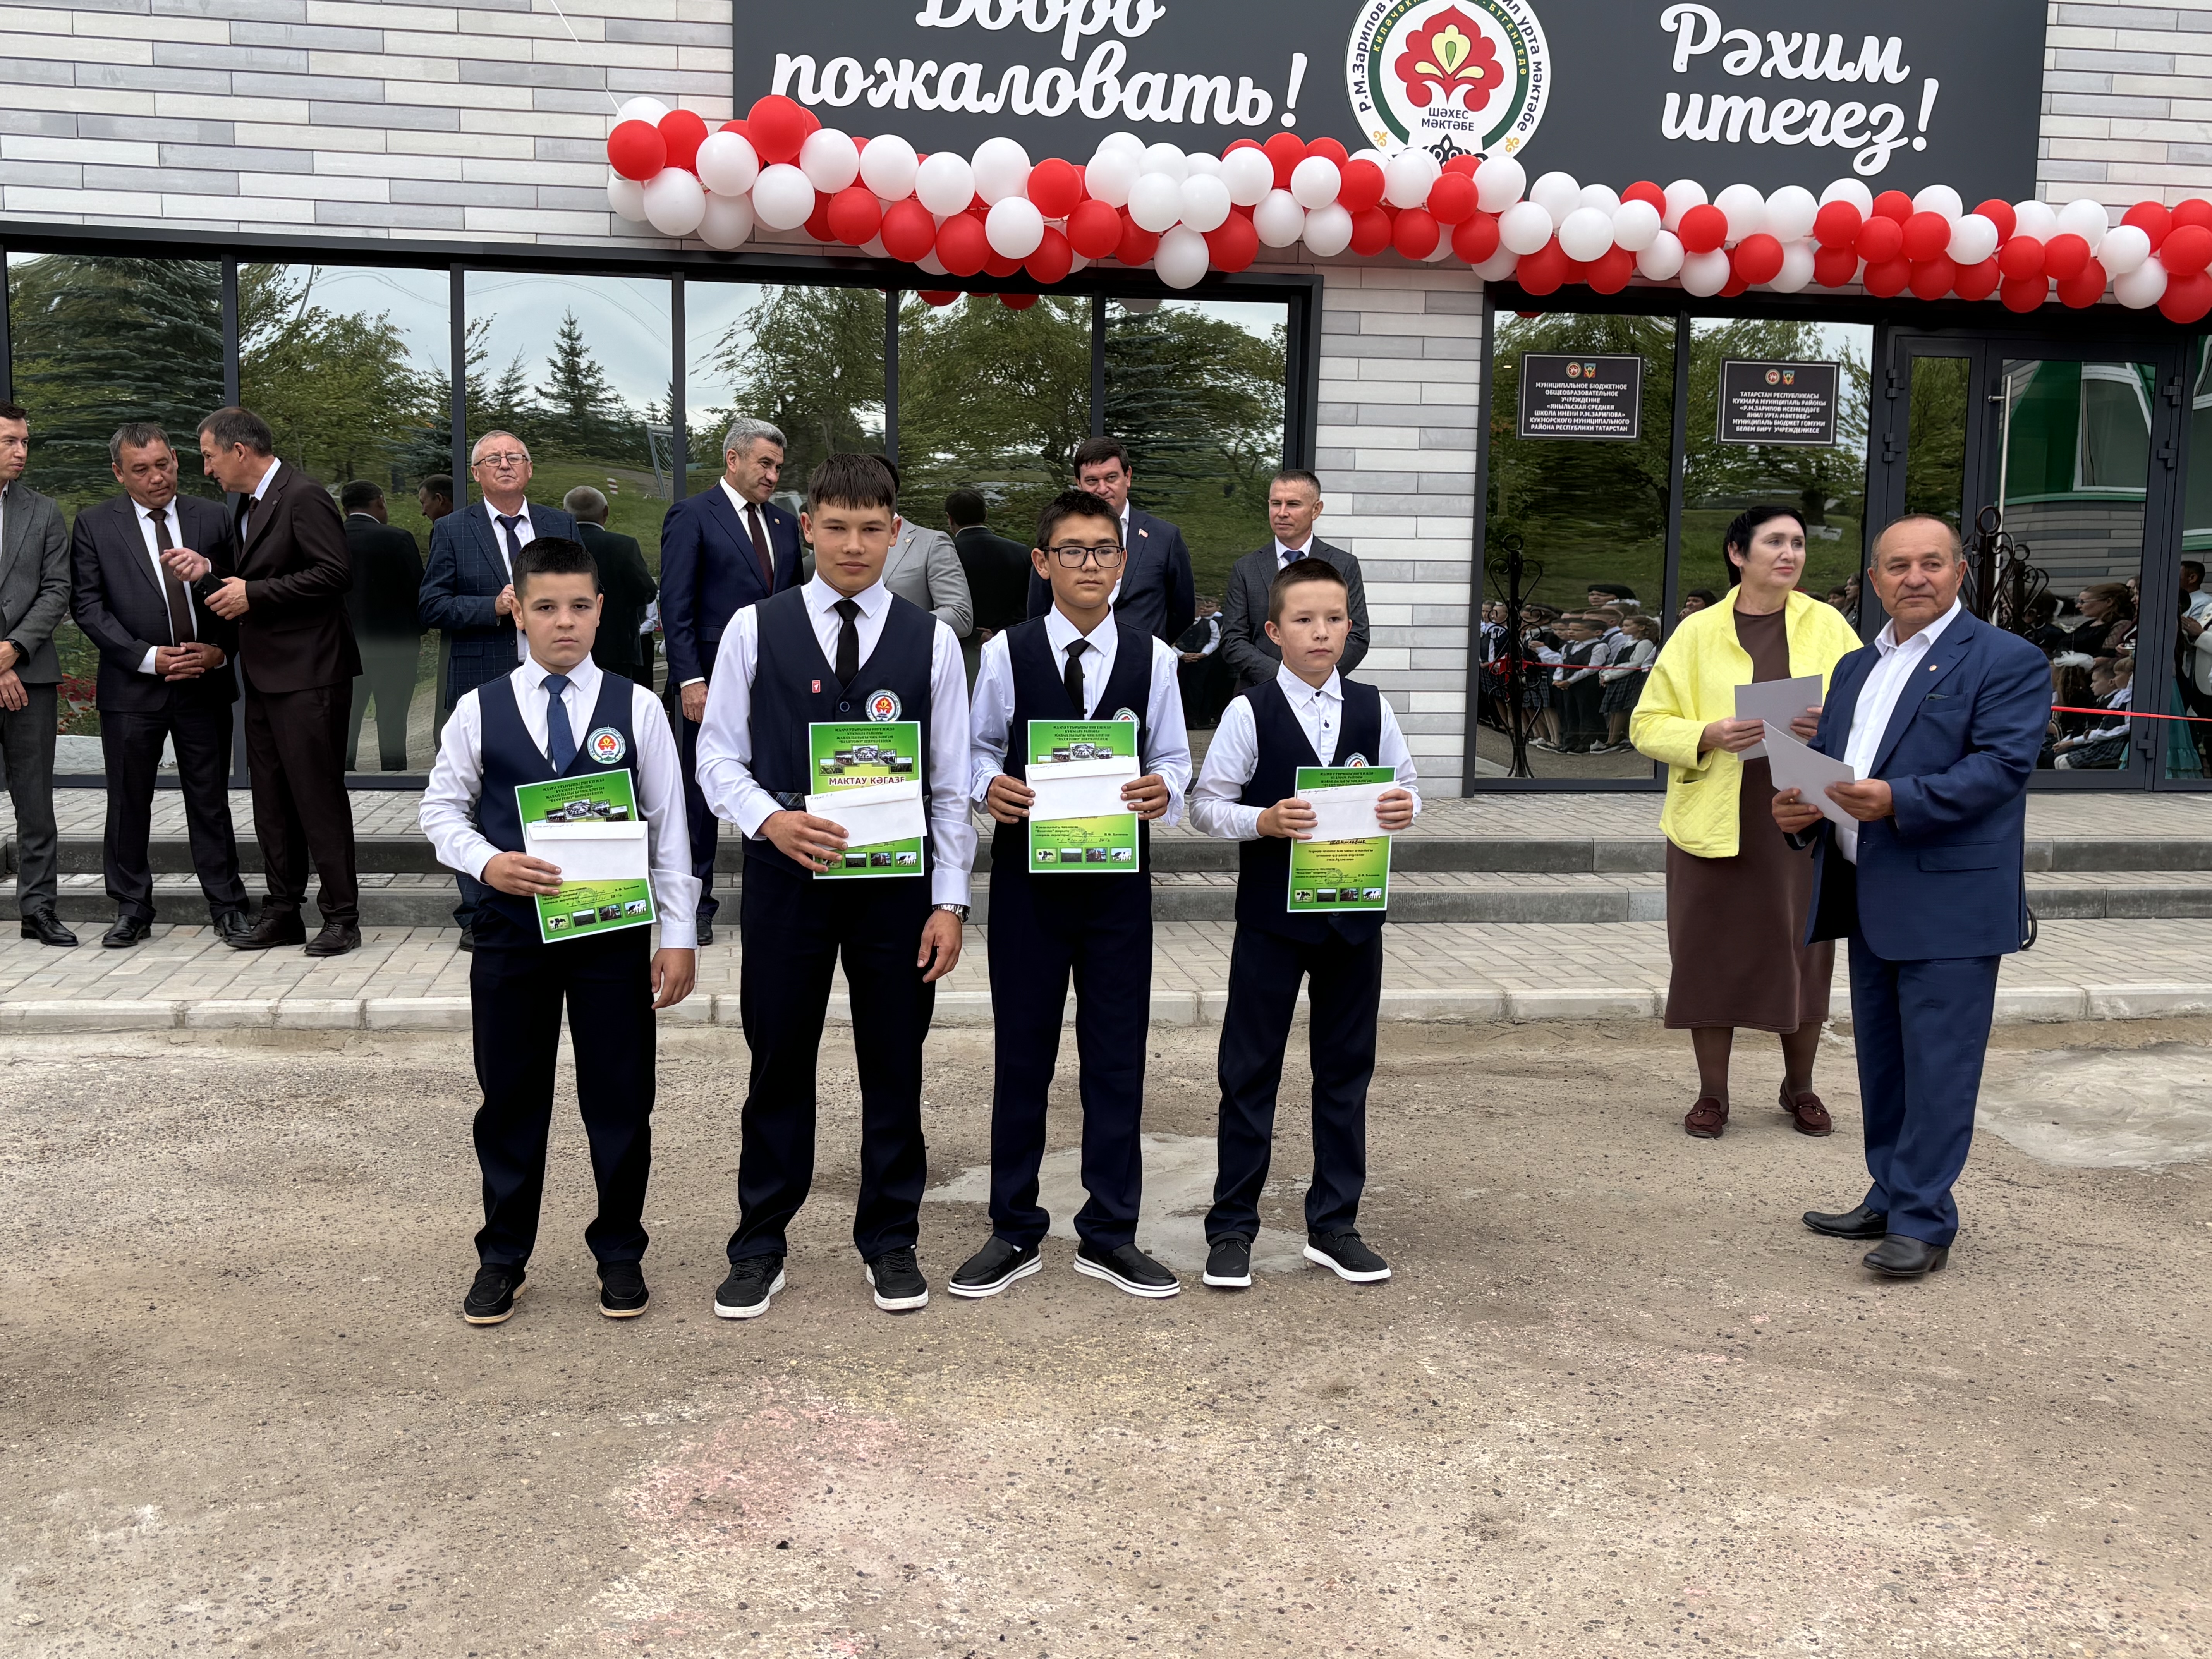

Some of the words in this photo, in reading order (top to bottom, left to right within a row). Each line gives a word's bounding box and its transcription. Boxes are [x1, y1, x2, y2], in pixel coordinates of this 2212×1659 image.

[771, 40, 1308, 127] пожаловать!
[1352, 2, 1386, 112] Р.М.Зарипов
[1660, 3, 1910, 84] Рәхим
[1422, 118, 1474, 131] МӘКТӘБЕ
[1429, 107, 1468, 119] ШӘХЕС
[1517, 61, 1542, 131] мәктәбе
[1661, 78, 1939, 176] итегез!
